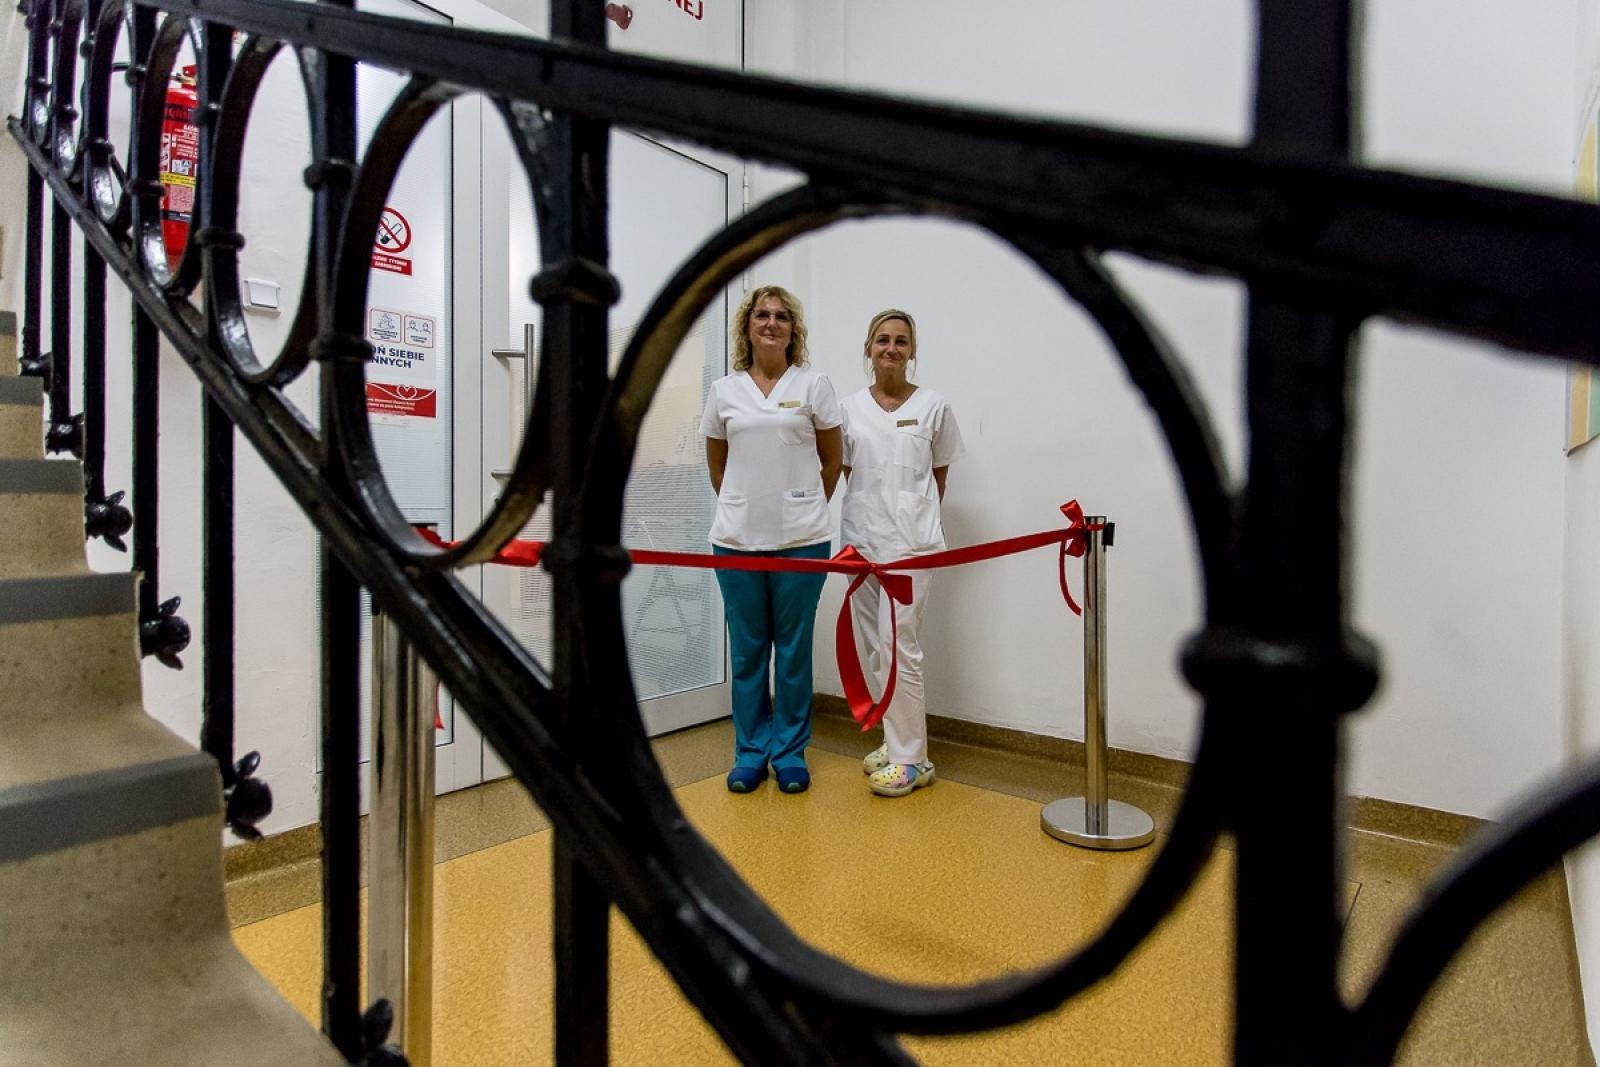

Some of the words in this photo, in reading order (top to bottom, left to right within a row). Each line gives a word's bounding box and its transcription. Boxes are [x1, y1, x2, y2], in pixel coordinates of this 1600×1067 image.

[668, 0, 704, 21] EJ
[388, 347, 425, 361] SIEBIE
[371, 355, 412, 369] NNYCH
